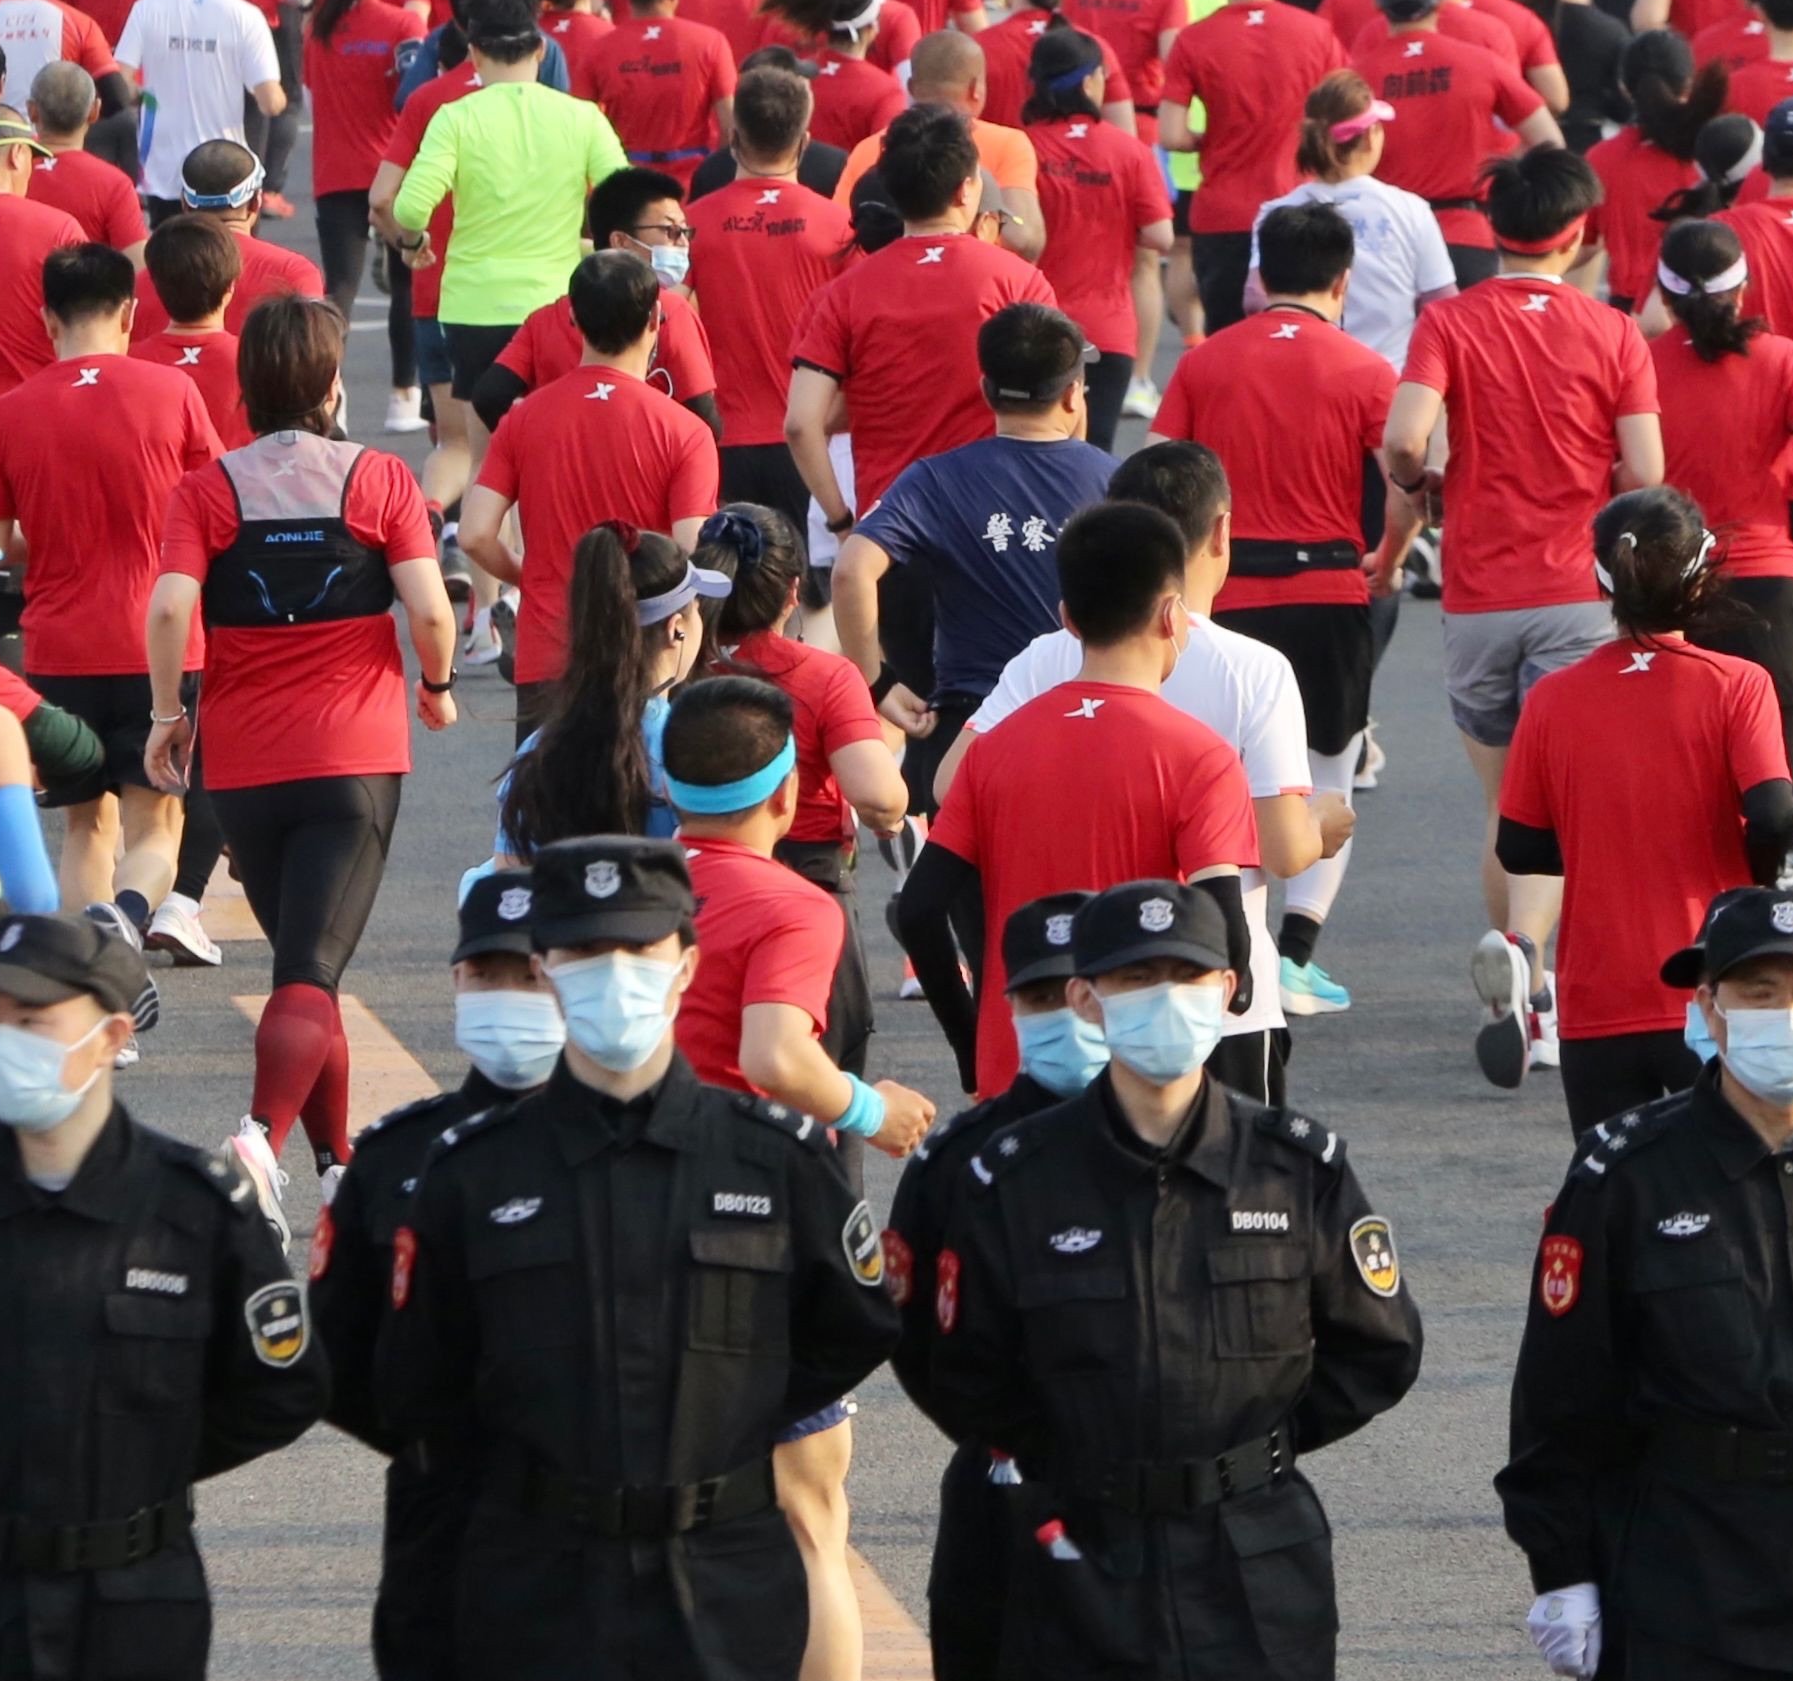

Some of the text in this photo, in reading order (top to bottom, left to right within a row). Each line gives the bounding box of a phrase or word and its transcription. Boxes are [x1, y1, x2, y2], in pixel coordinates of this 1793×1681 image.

[264, 530, 326, 543] AONIJIE
[982, 512, 1066, 553] 警察
[714, 1193, 772, 1215] DB0123
[1232, 1211, 1289, 1231] DB0104
